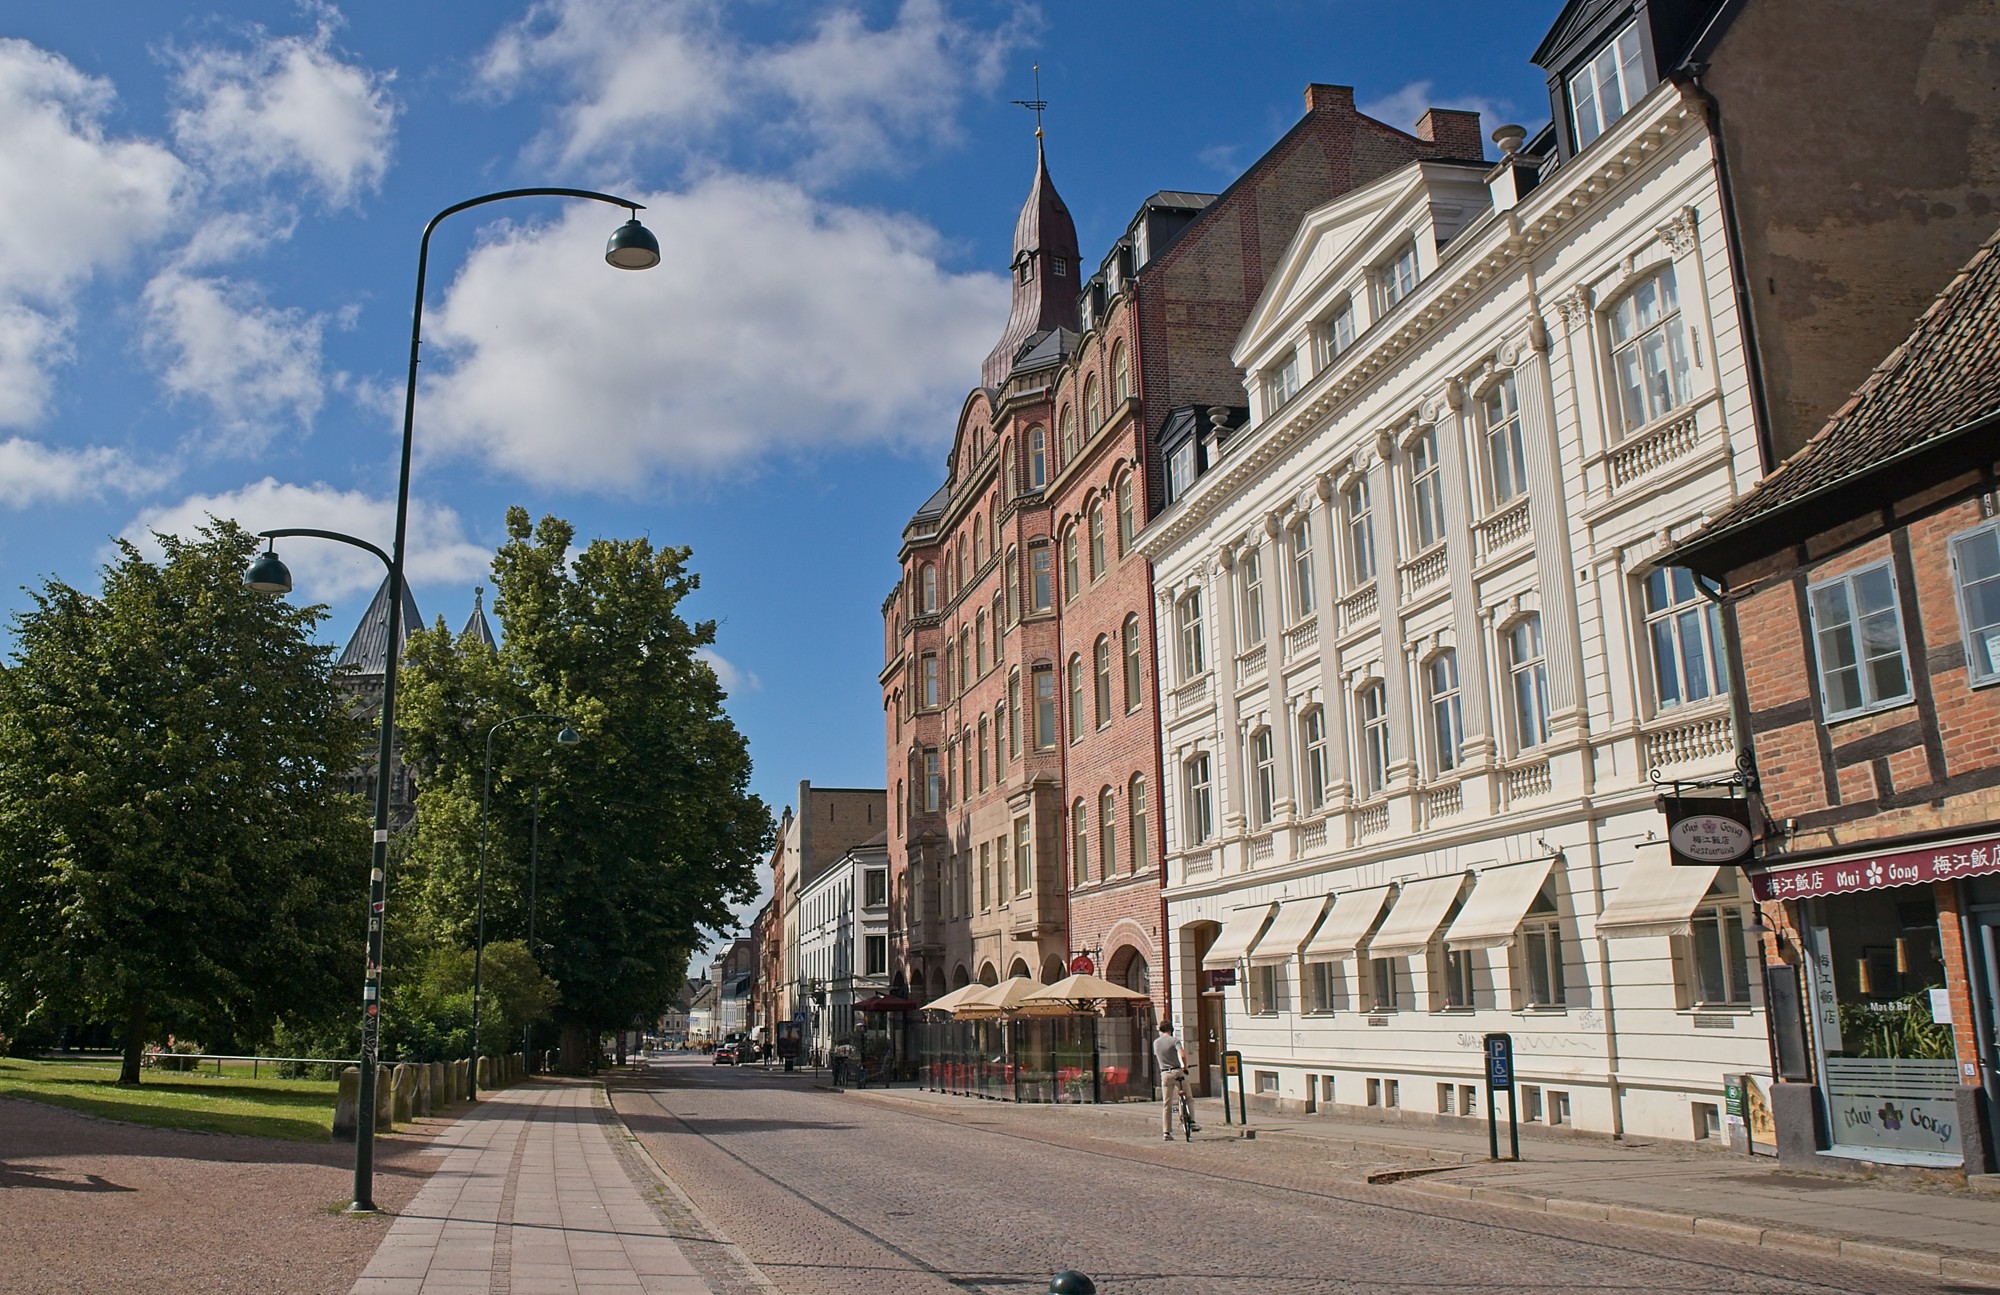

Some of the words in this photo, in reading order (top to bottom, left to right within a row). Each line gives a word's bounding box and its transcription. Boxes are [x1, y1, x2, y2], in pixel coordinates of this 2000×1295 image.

[1682, 822, 1698, 834] Mui
[1720, 821, 1743, 838] Gong
[1693, 835, 1730, 845] 梅江飯店
[1690, 844, 1735, 856] Restaurang
[1766, 871, 1824, 895] 梅江飯店
[1836, 870, 1860, 888] Mui
[1888, 863, 1918, 881] Gong
[1870, 1002, 1887, 1012] Mat
[1888, 1001, 1895, 1011] &
[1897, 1001, 1912, 1011] Bar
[1494, 1042, 1504, 1057] P
[1844, 1105, 1873, 1128] Mui
[1910, 1107, 1952, 1143] Gong
